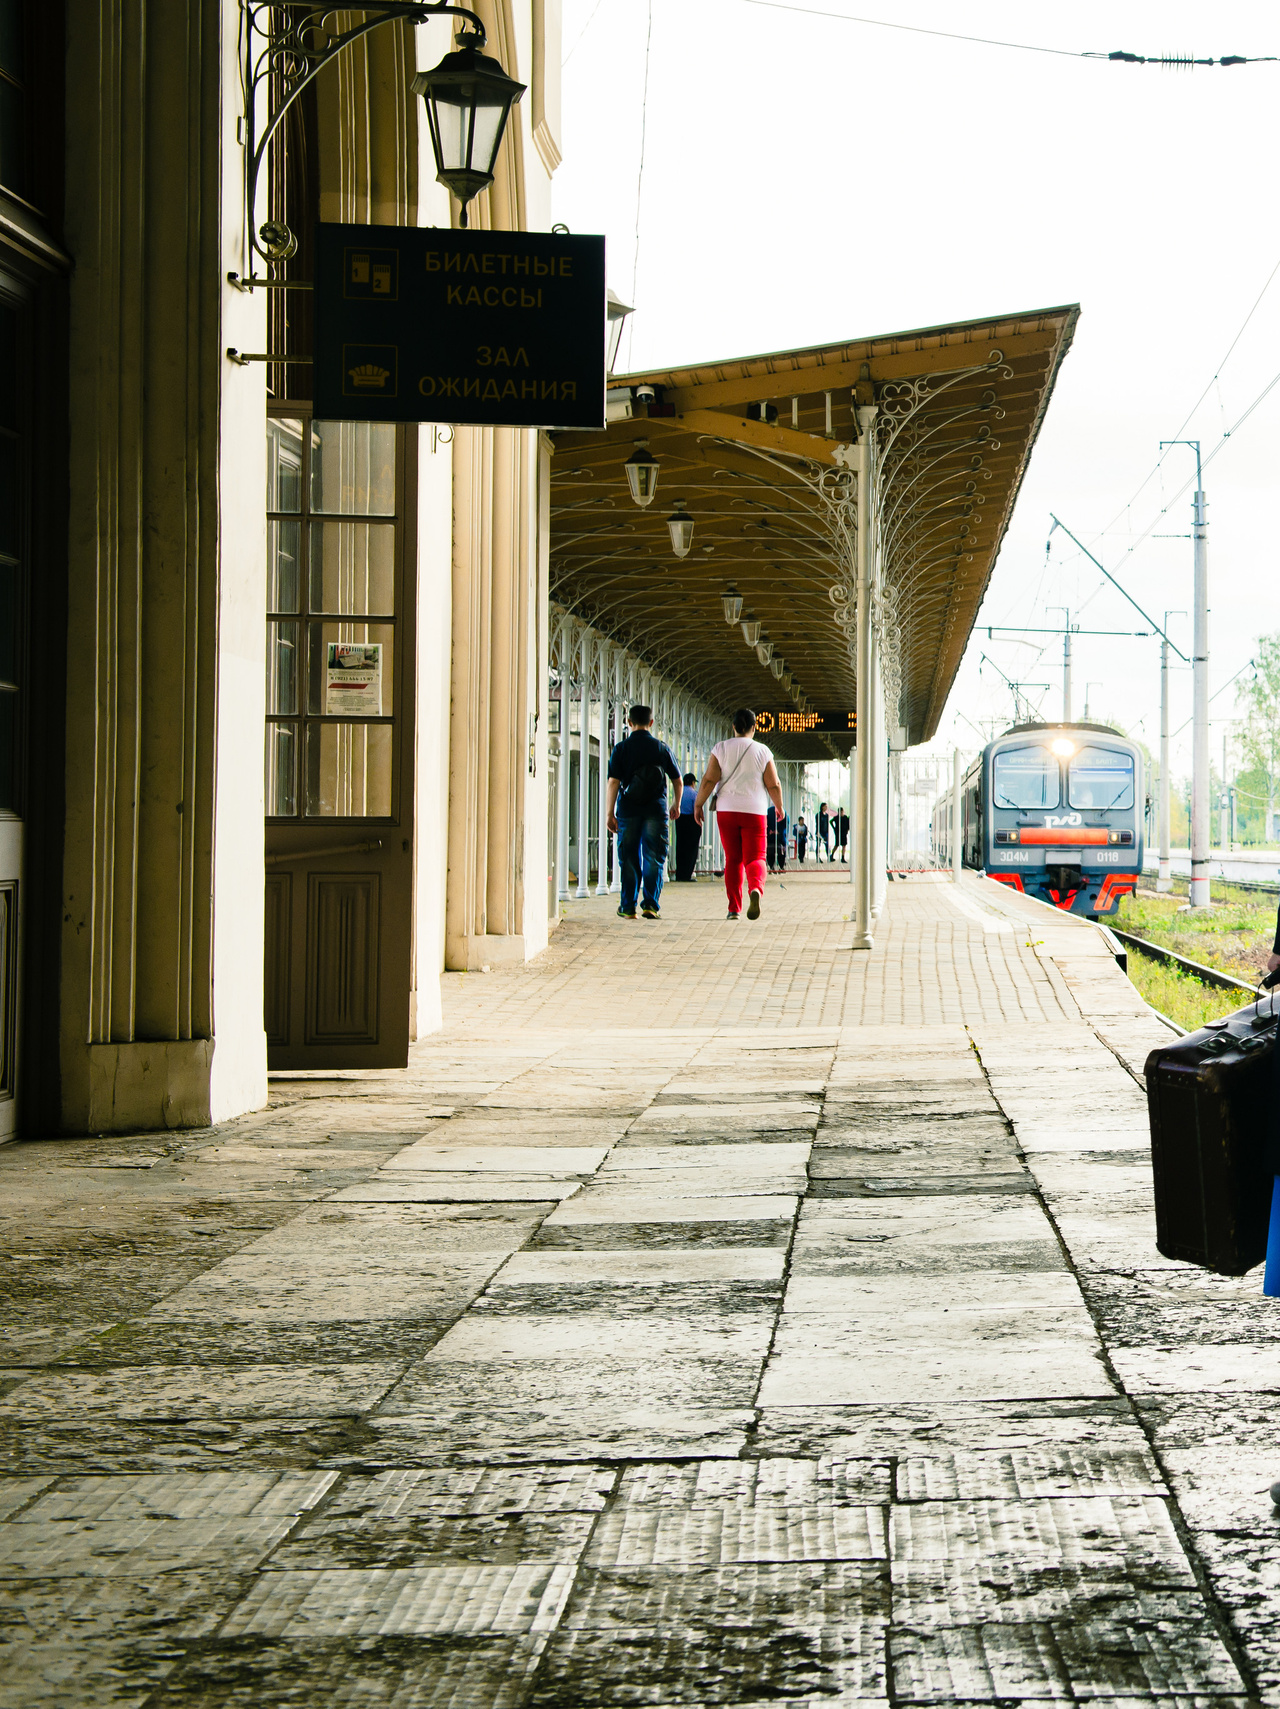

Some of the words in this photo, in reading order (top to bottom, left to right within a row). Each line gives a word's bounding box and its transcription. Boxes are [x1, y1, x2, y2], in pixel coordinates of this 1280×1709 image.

[425, 251, 573, 277] БИЛЕТНЫЕ
[446, 285, 542, 308] КАССЫ
[476, 346, 529, 367] ЗАЛ
[418, 376, 577, 401] ОЖИДАНИЯ
[1000, 851, 1029, 862] ЭД4М
[1097, 851, 1119, 862] 0118
